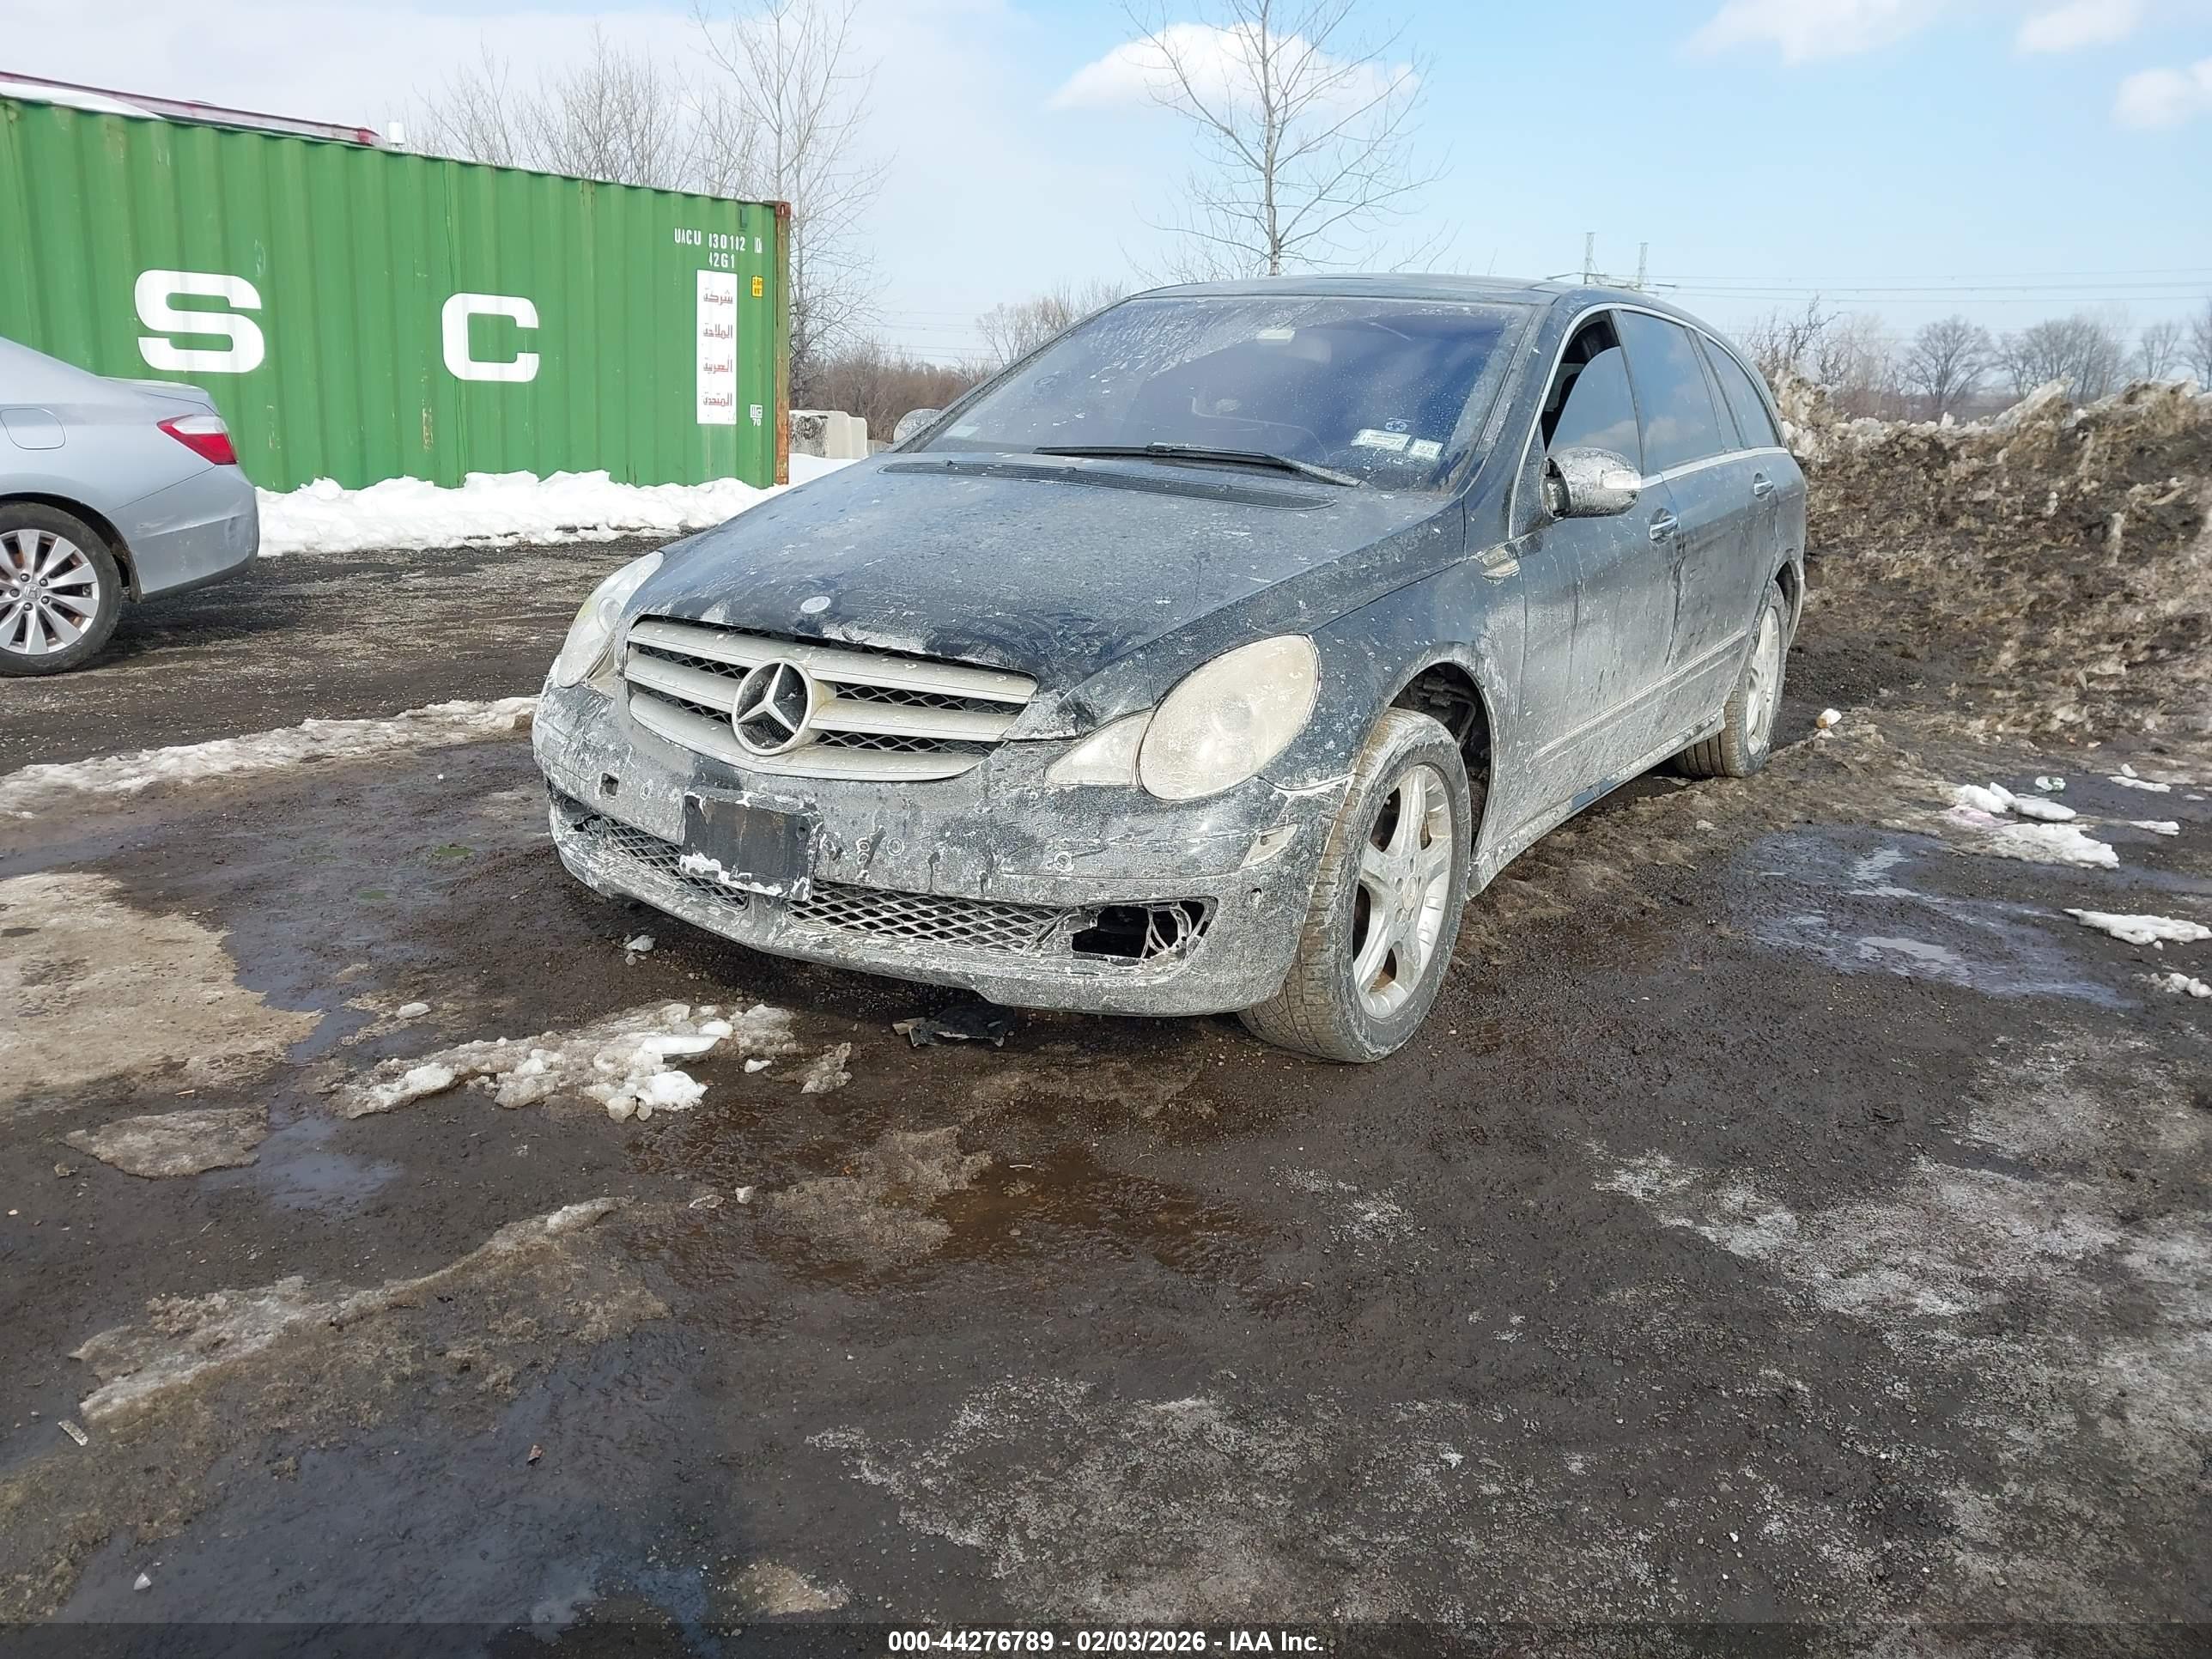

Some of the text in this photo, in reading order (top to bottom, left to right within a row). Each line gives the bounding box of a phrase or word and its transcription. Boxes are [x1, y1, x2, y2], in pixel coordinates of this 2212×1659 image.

[674, 228, 702, 246] UACU
[134, 270, 539, 382] S C
